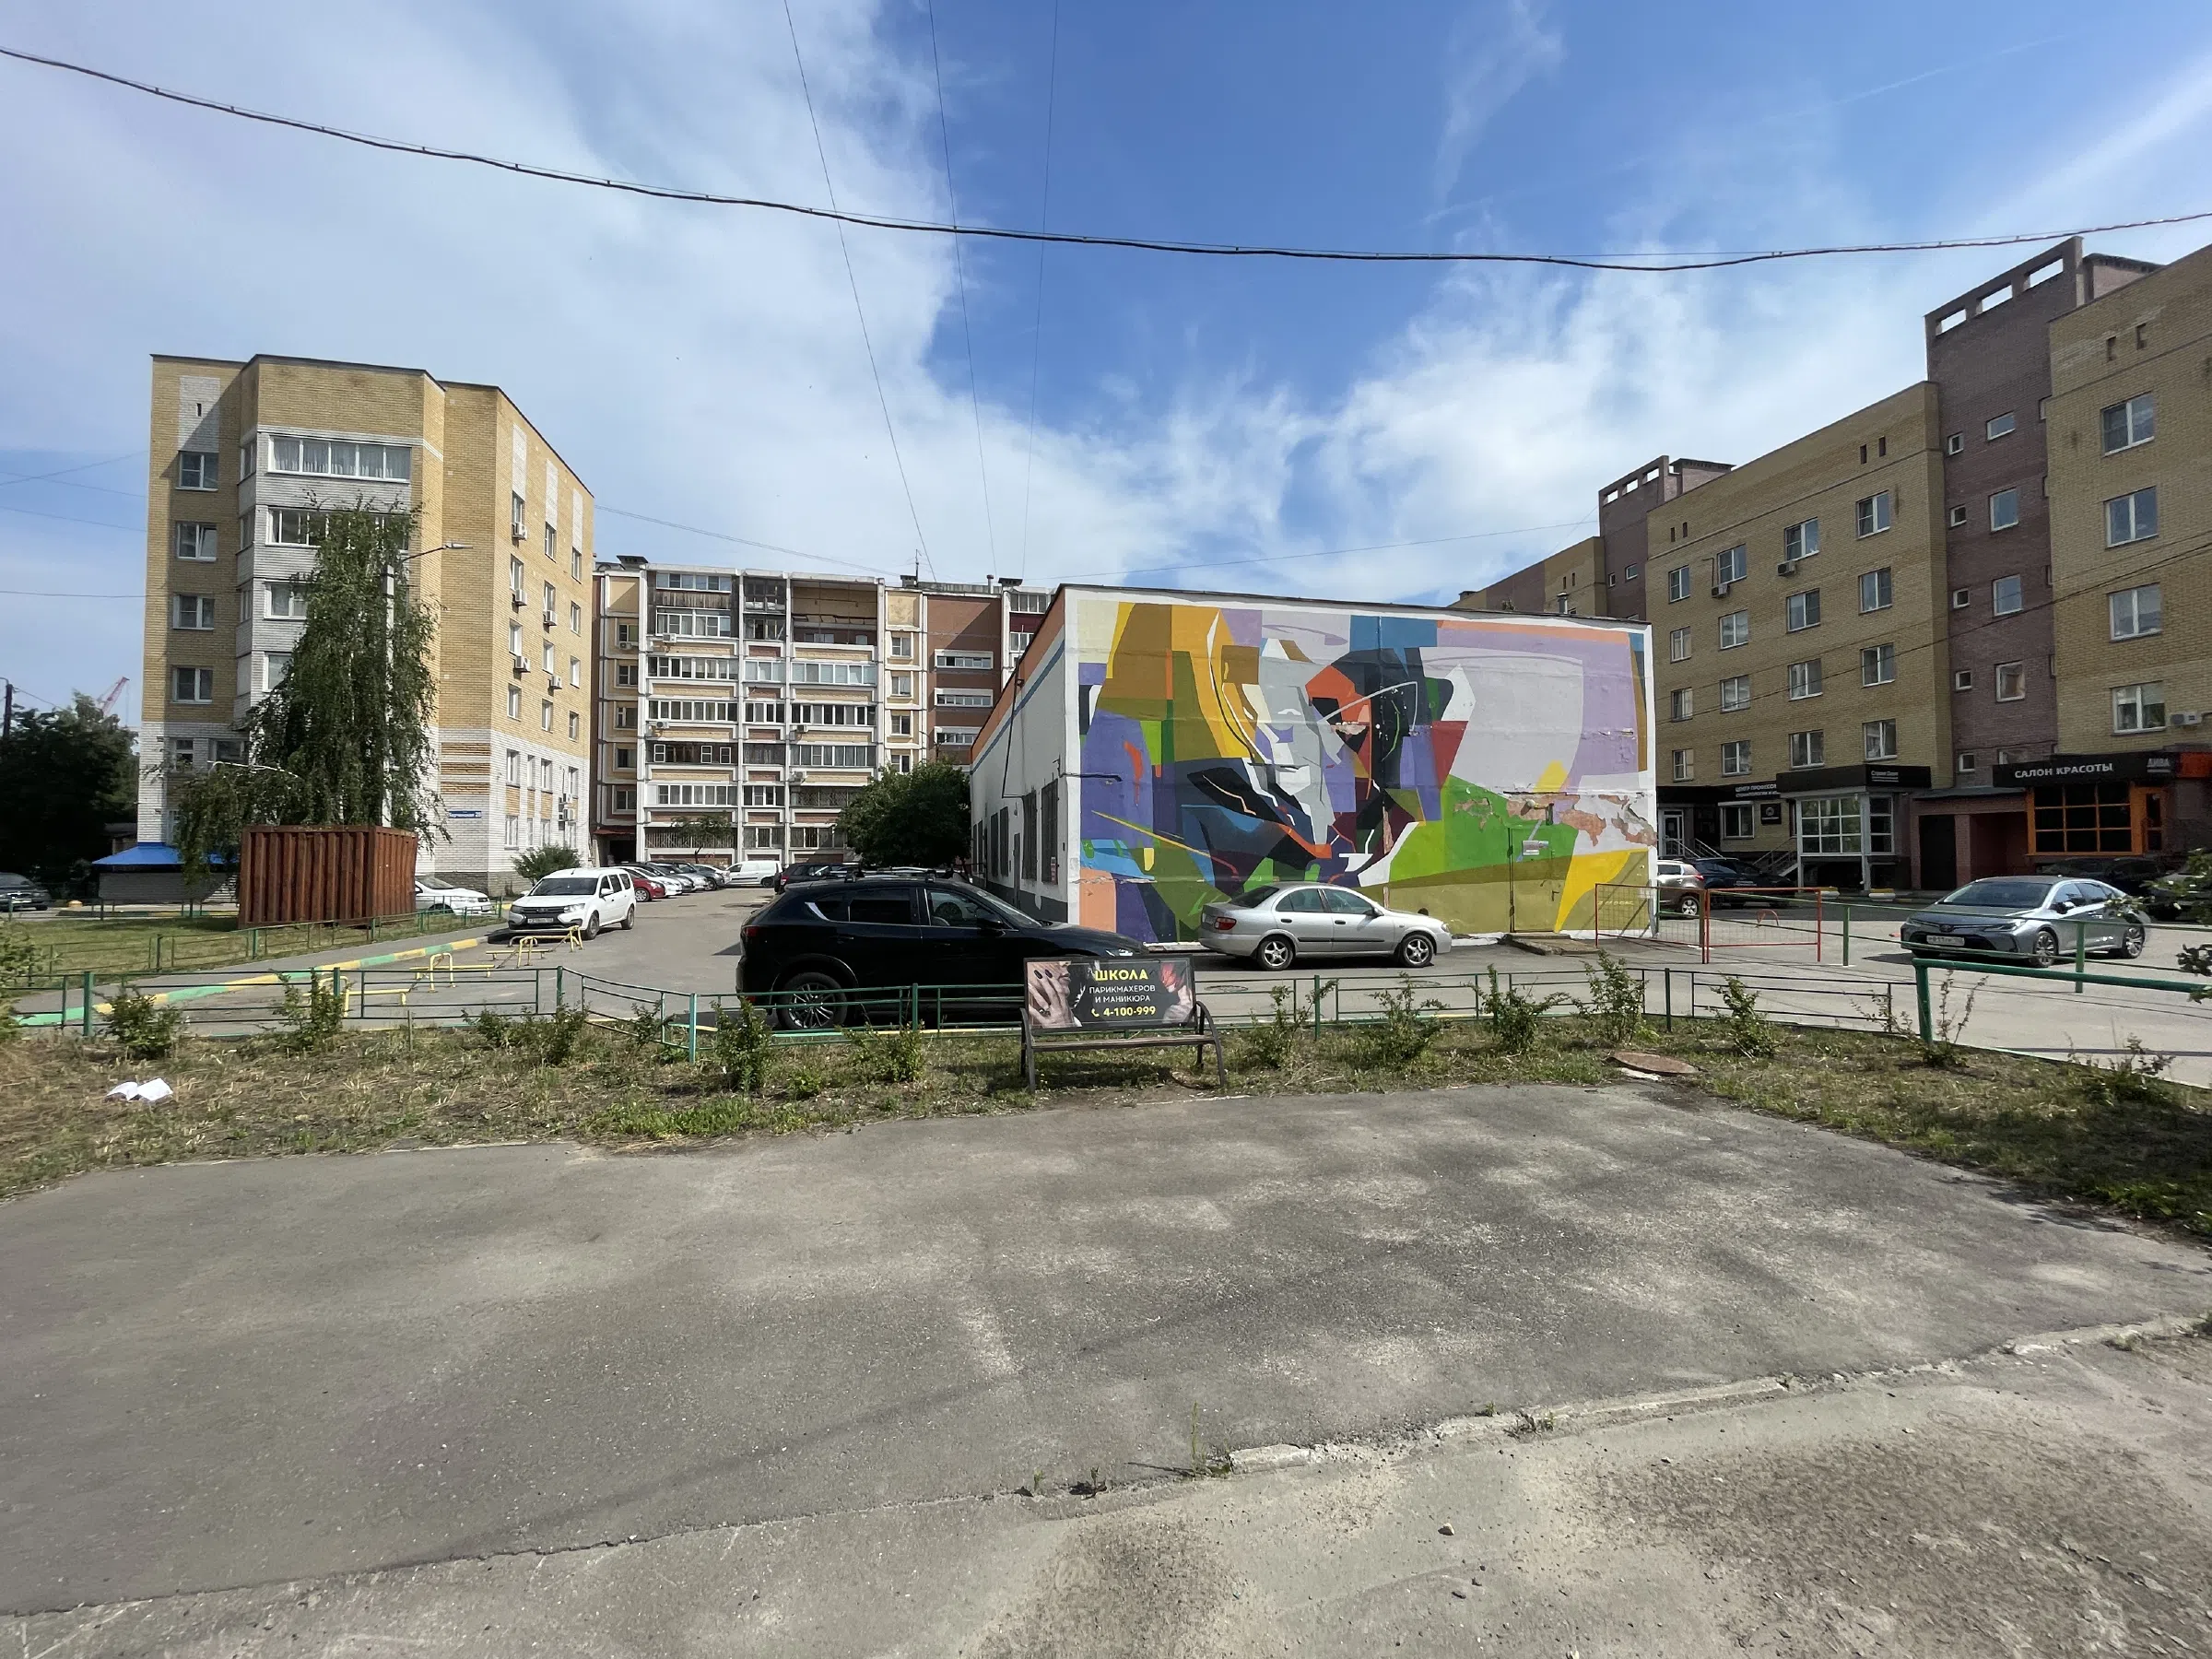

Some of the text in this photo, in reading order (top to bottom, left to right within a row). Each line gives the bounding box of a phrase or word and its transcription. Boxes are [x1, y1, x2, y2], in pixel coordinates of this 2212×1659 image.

[2015, 763, 2112, 778] САЛОН КРАСОТЫ
[1095, 969, 1148, 981] ШКОЛА
[1088, 985, 1156, 994] ПАРИКМАХЕРОВ
[1102, 994, 1151, 1003] МАНИКЮРА
[1103, 1006, 1156, 1017] 4-100-999
